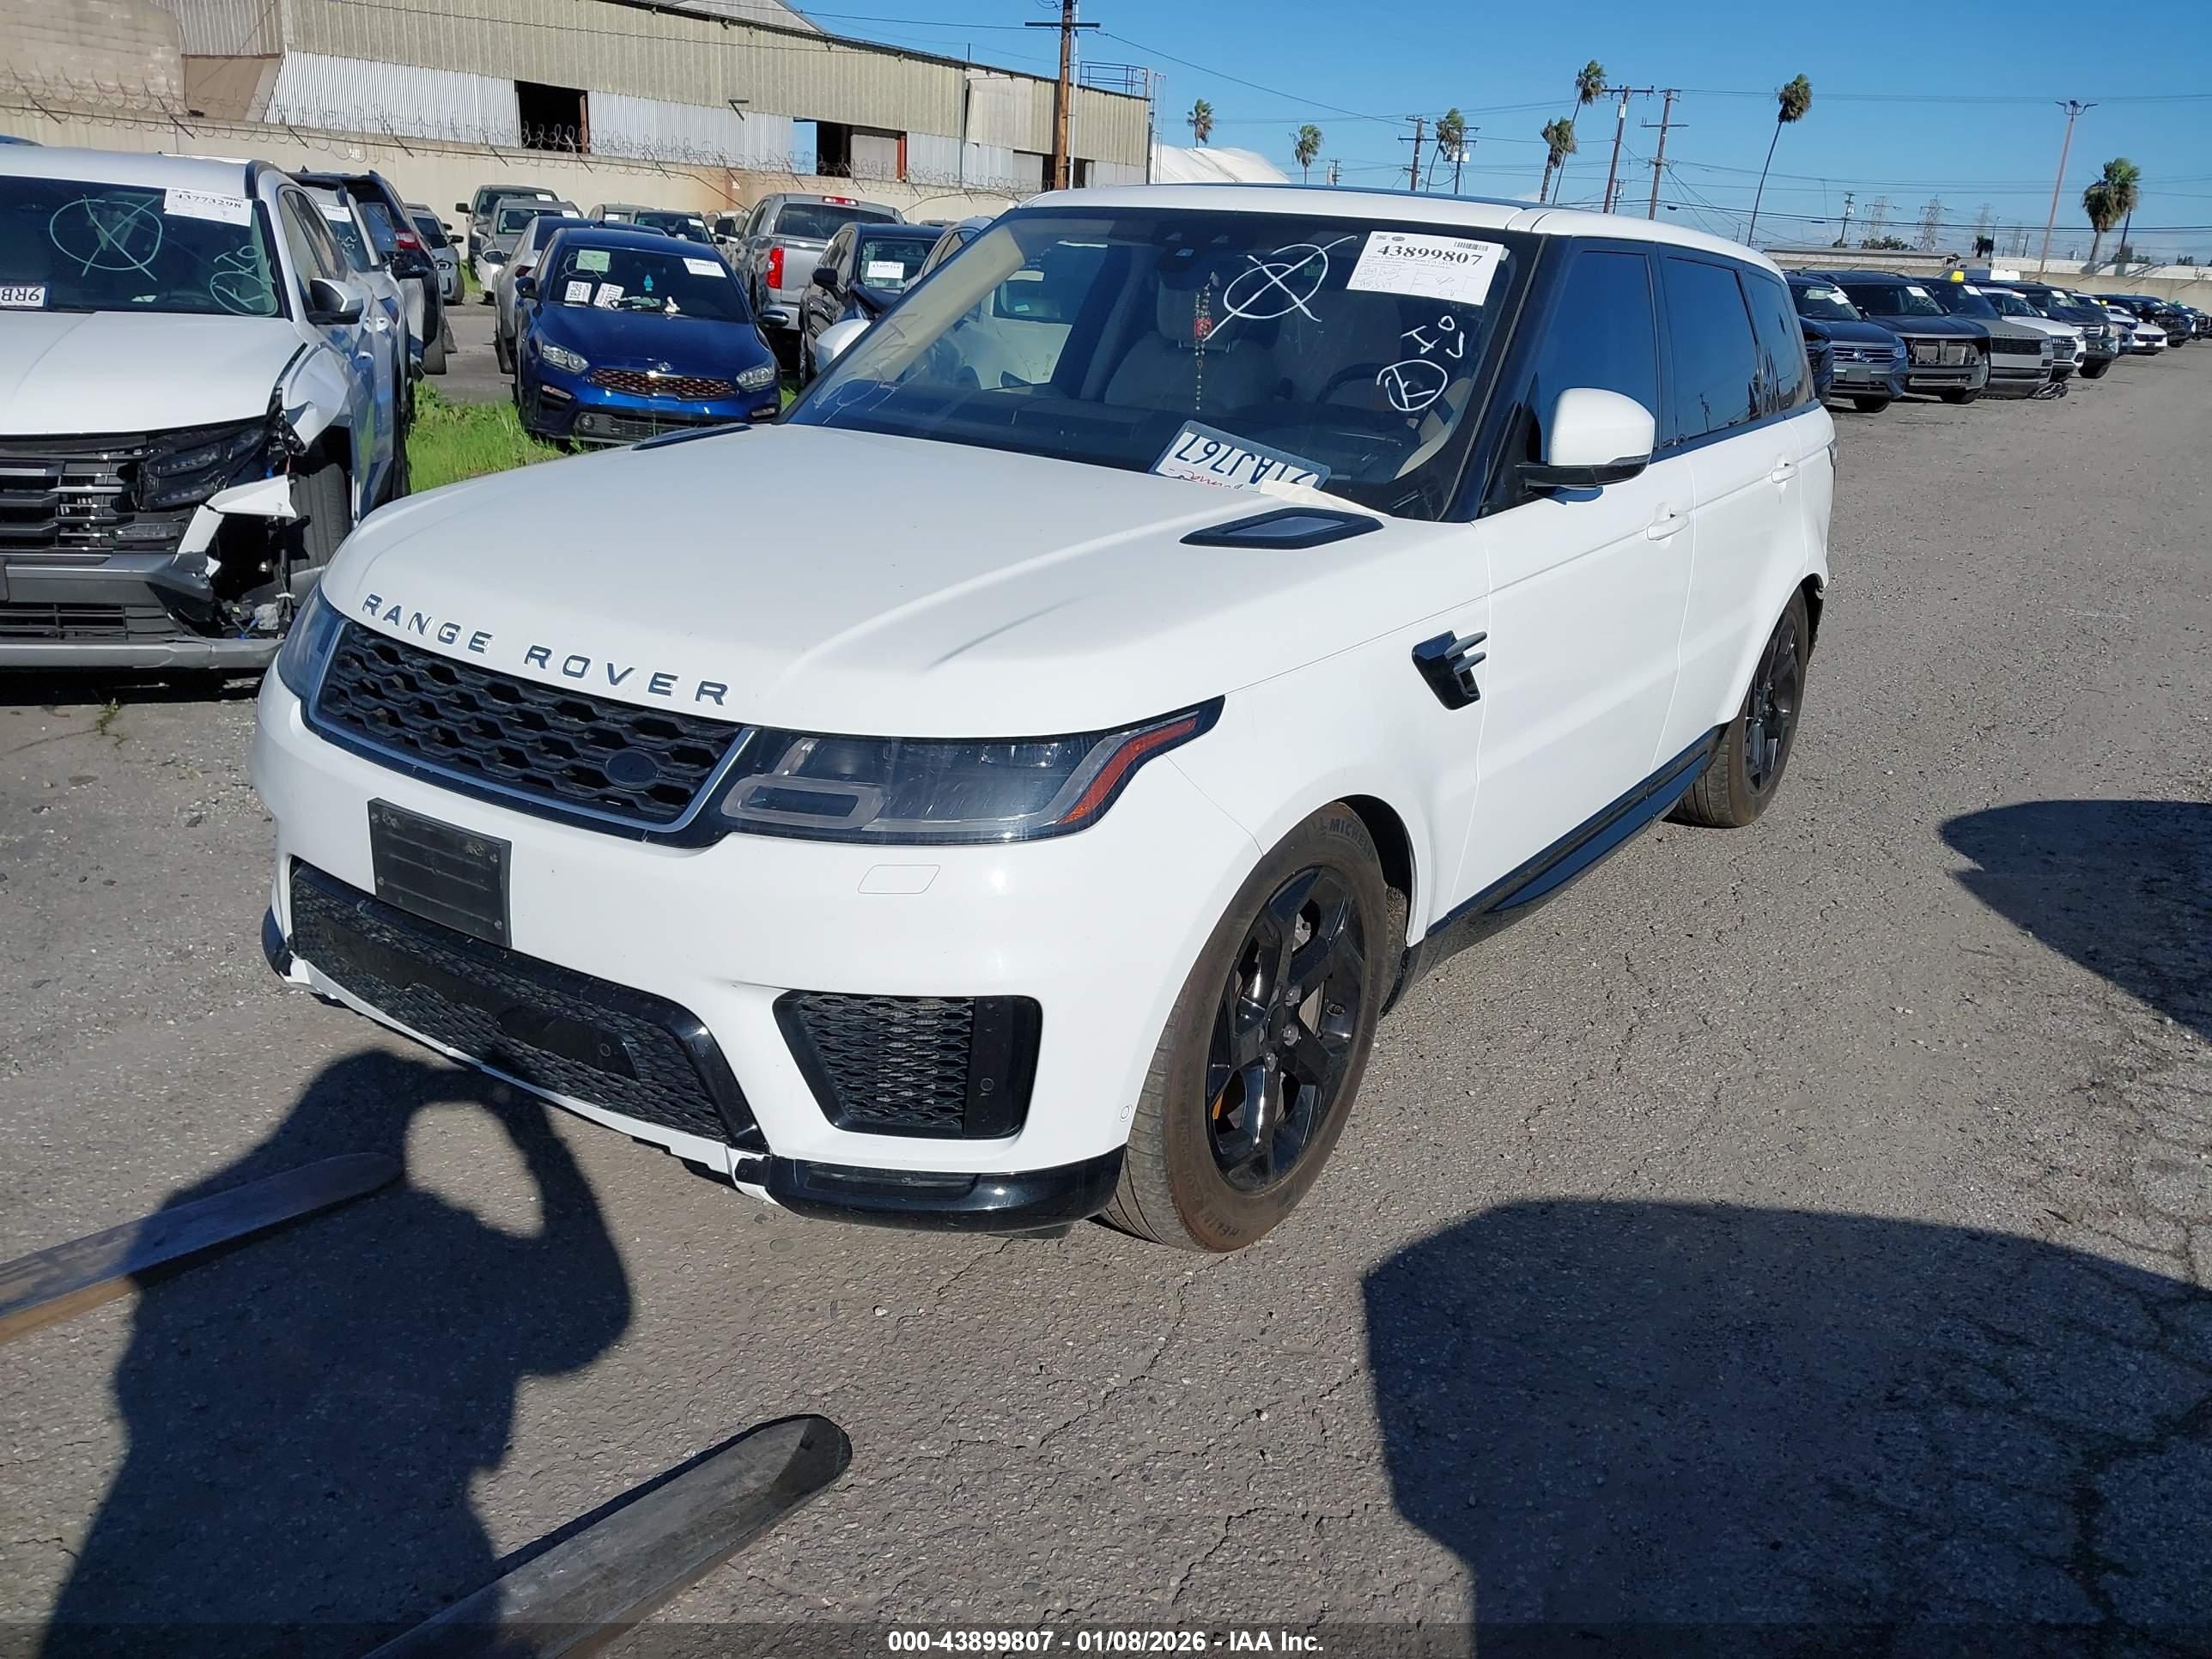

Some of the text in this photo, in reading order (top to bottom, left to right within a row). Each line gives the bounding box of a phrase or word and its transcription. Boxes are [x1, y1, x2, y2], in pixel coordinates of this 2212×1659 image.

[1376, 245, 1484, 266] 43899807
[361, 592, 730, 707] RANGE ROVER
